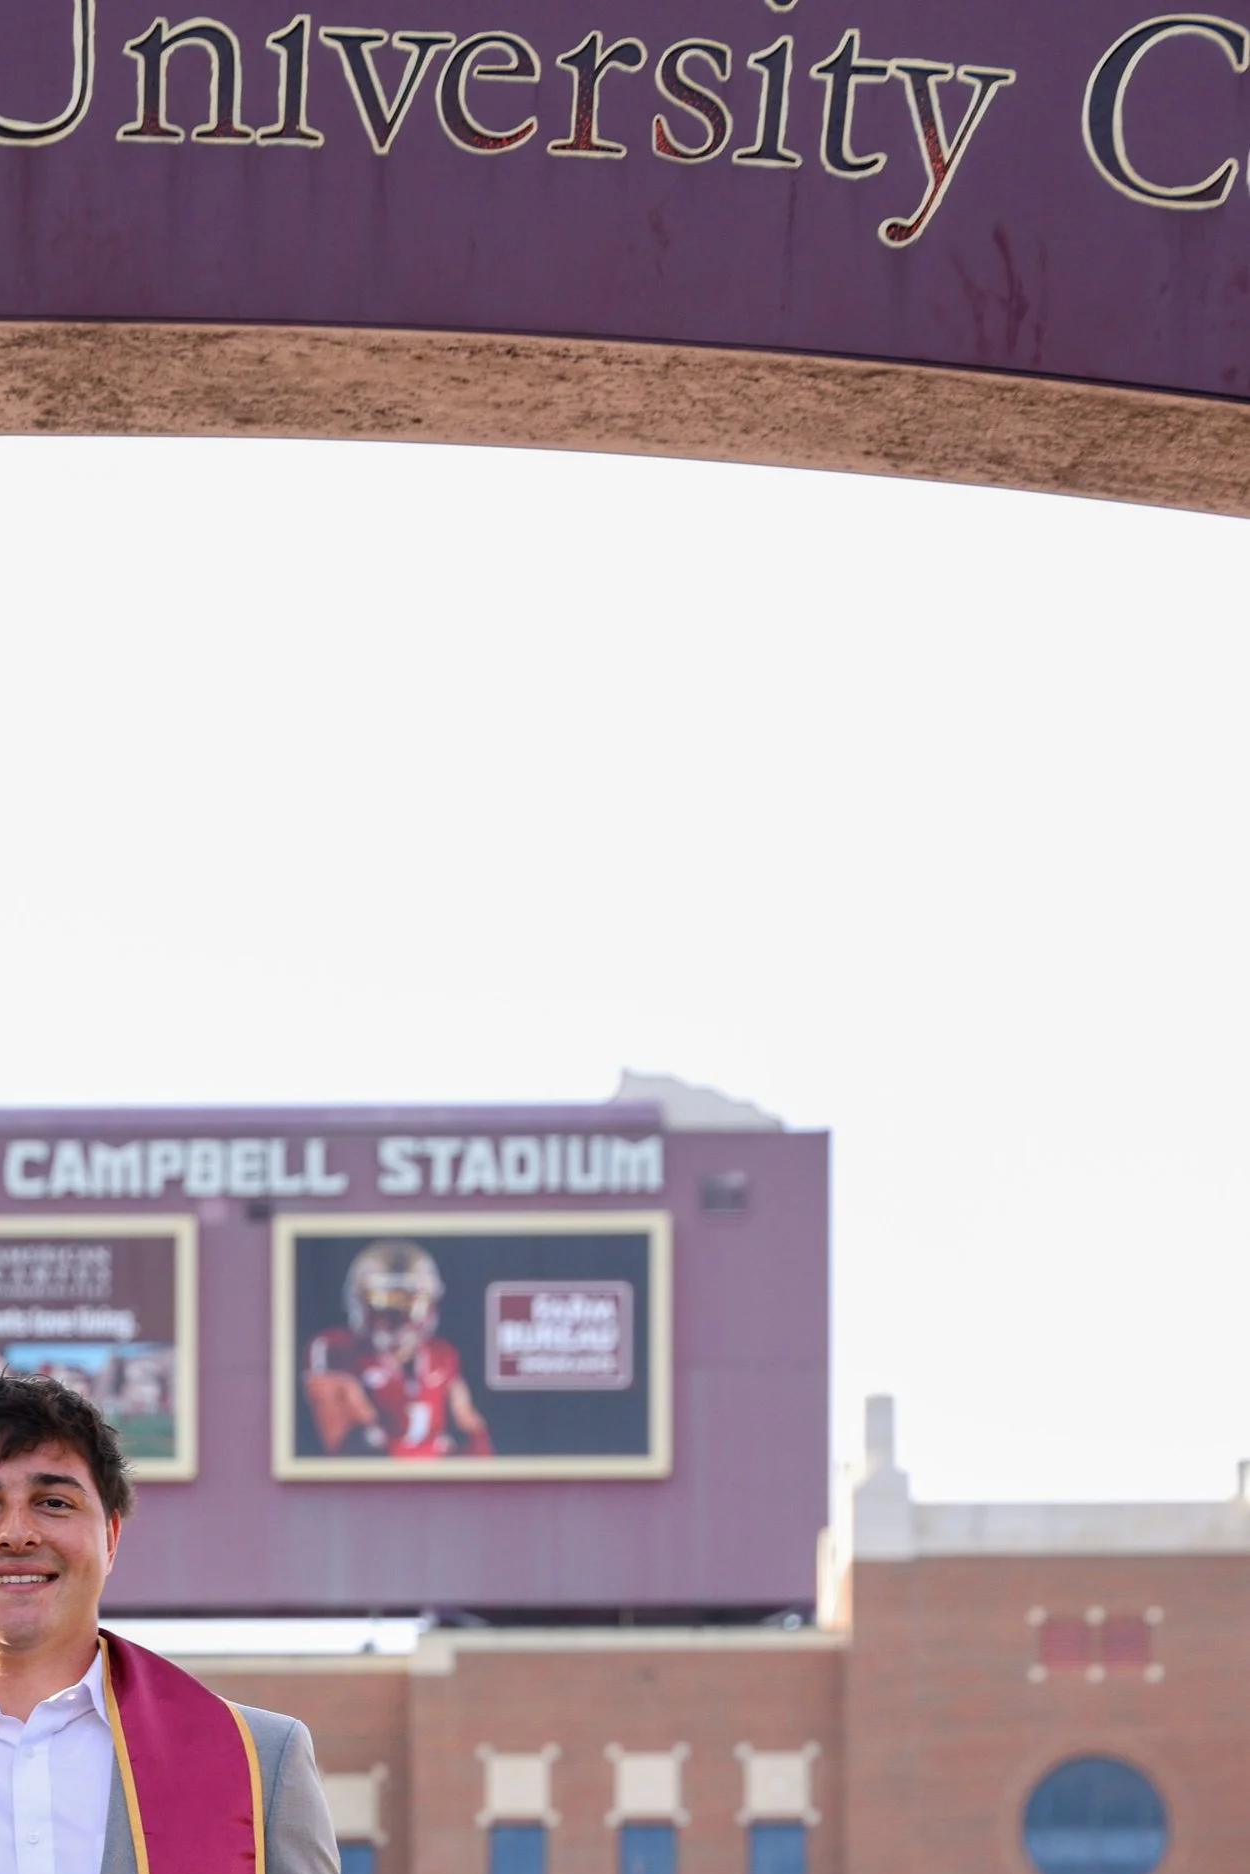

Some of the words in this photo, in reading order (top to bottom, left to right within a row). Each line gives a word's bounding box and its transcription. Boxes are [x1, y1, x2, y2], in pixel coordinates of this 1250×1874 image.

[1082, 13, 1250, 210] C
[2, 1138, 348, 1198] CAMPBELL
[377, 1134, 663, 1195] STADIUM
